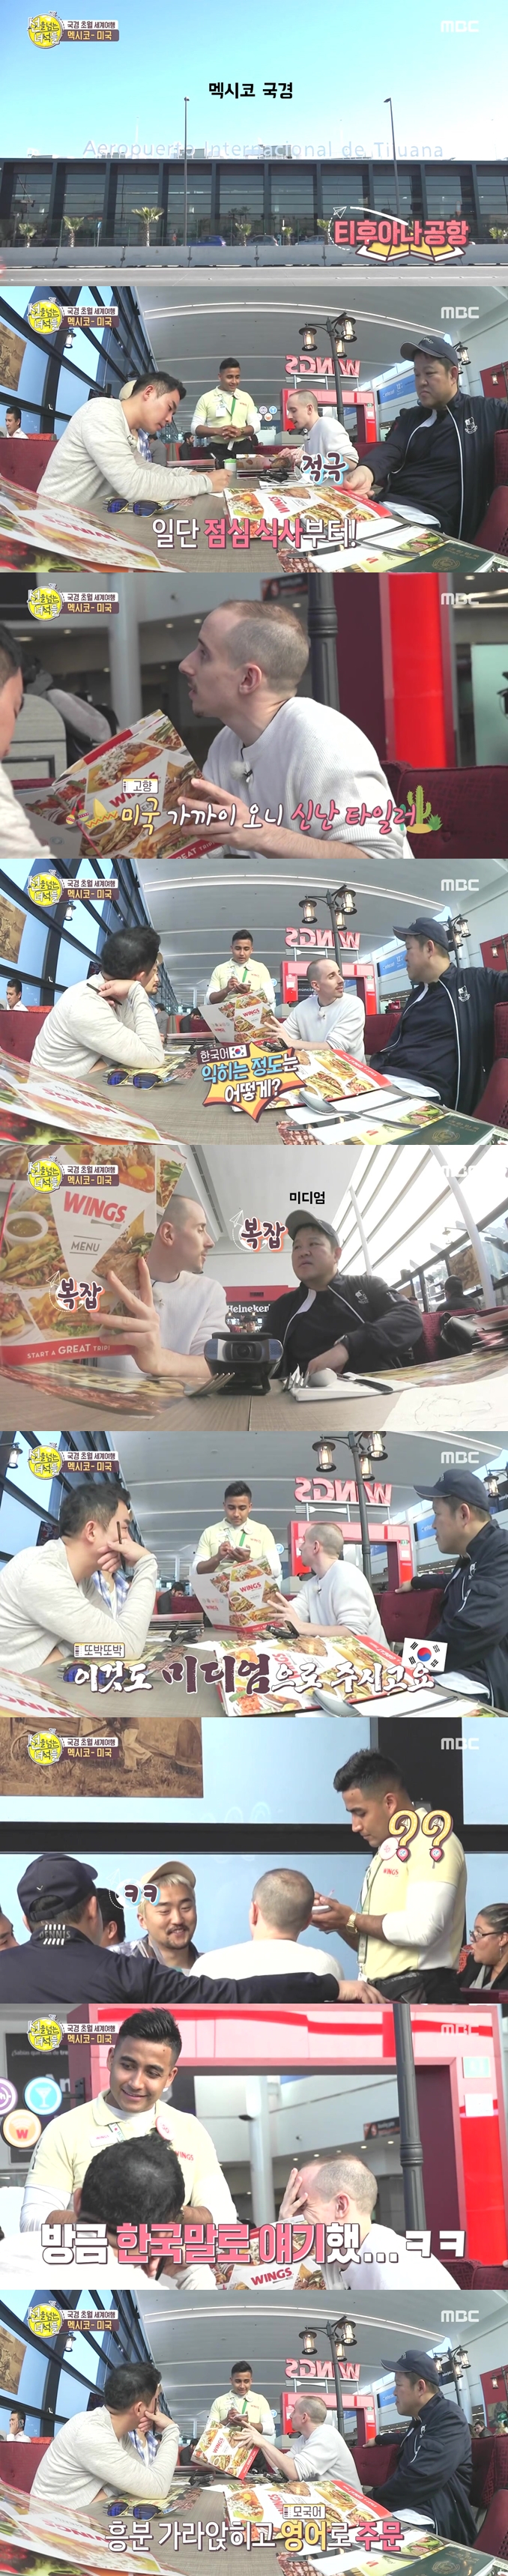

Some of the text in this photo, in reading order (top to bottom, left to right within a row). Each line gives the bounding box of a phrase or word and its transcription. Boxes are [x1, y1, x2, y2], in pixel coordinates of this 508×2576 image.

[82, 140, 444, 160] Aeropuerto Internacional de Tiuana
[267, 496, 290, 514] WINGS
[42, 514, 118, 542] WINGS
[242, 1008, 261, 1018] WINGS
[42, 1087, 118, 1115] WINGS
[63, 1191, 128, 1224] WINGS
[70, 1241, 100, 1253] MENU
[227, 1304, 270, 1313] Heineken
[27, 1351, 49, 1359] START
[58, 1343, 91, 1355] GREAT
[239, 1582, 262, 1593] WINGS
[39, 1931, 71, 1939] DENNIS
[16, 2129, 28, 2139] W
[251, 2267, 293, 2286] WINGS
[212, 2437, 224, 2454] WINGS
